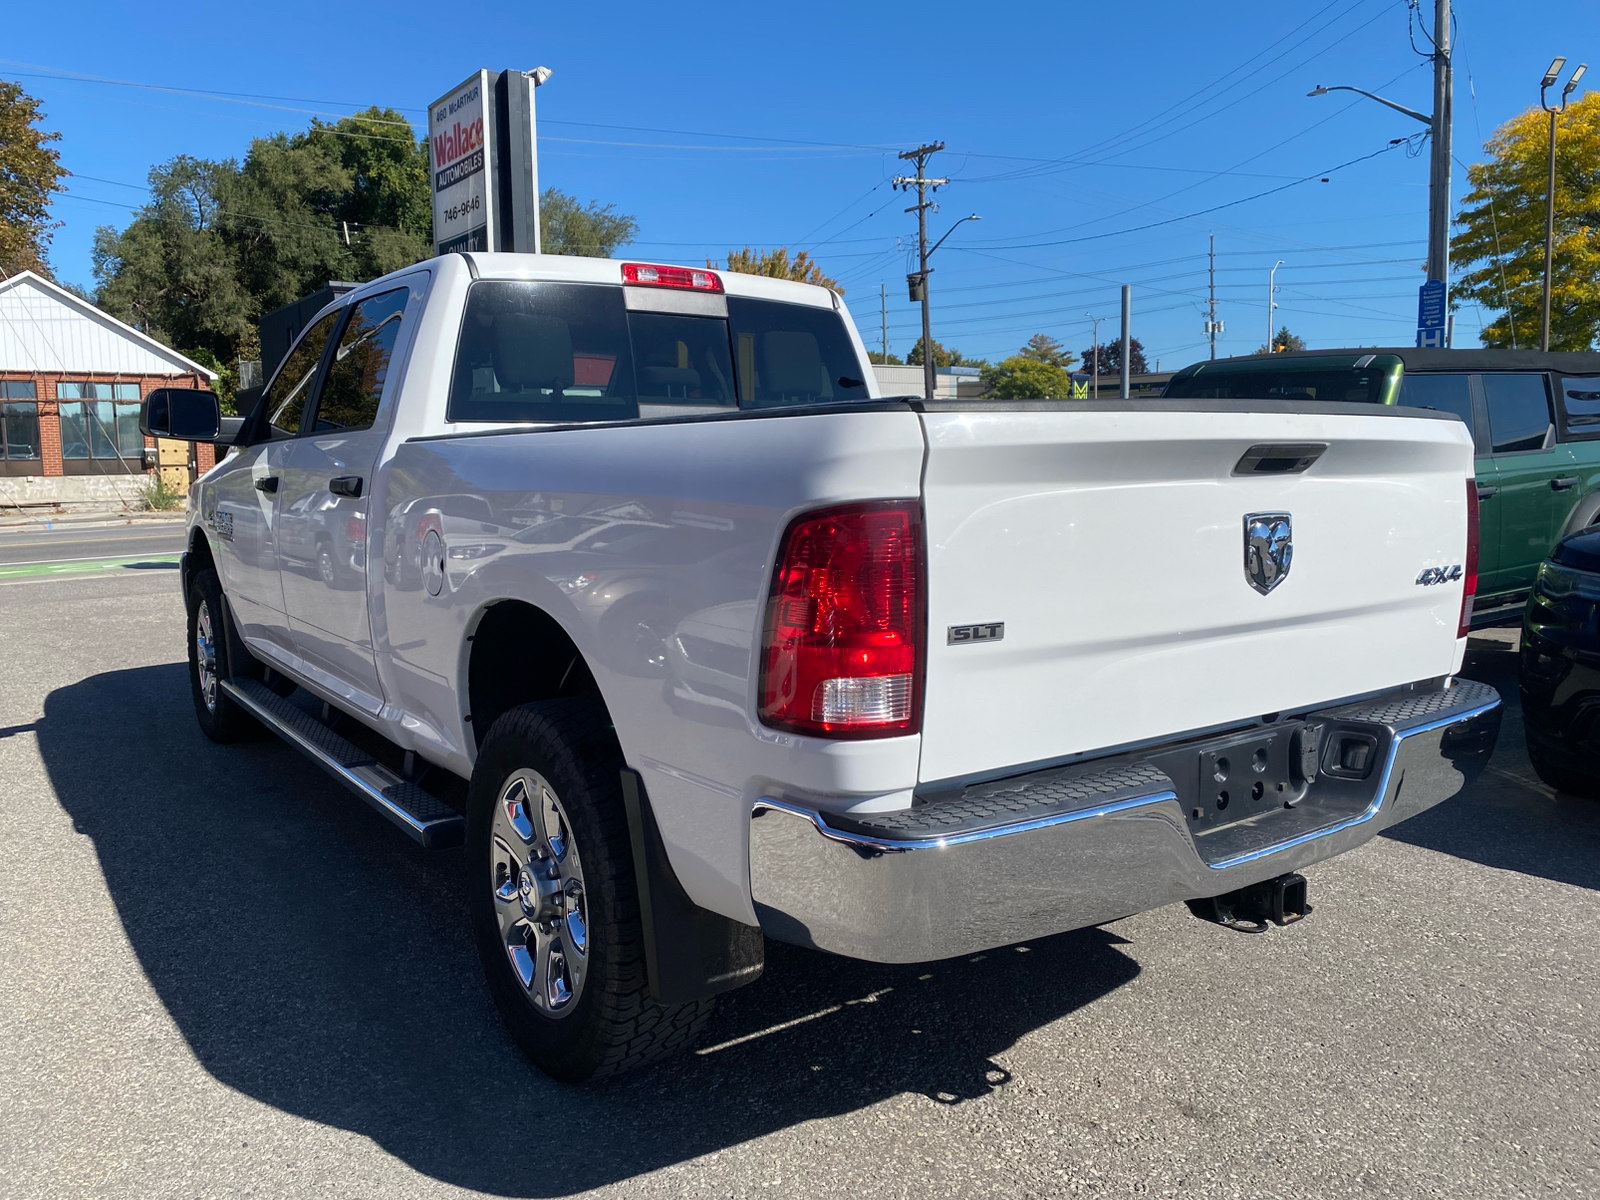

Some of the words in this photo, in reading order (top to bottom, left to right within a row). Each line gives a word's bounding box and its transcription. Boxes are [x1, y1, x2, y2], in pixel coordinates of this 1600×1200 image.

[436, 108, 446, 122] 460
[449, 87, 479, 115] McARTHUR
[434, 117, 483, 168] Wallace
[438, 152, 482, 188] AUTOMOBILES
[444, 195, 480, 224] 746-9646
[1421, 330, 1441, 347] H
[954, 624, 1002, 641] SLT
